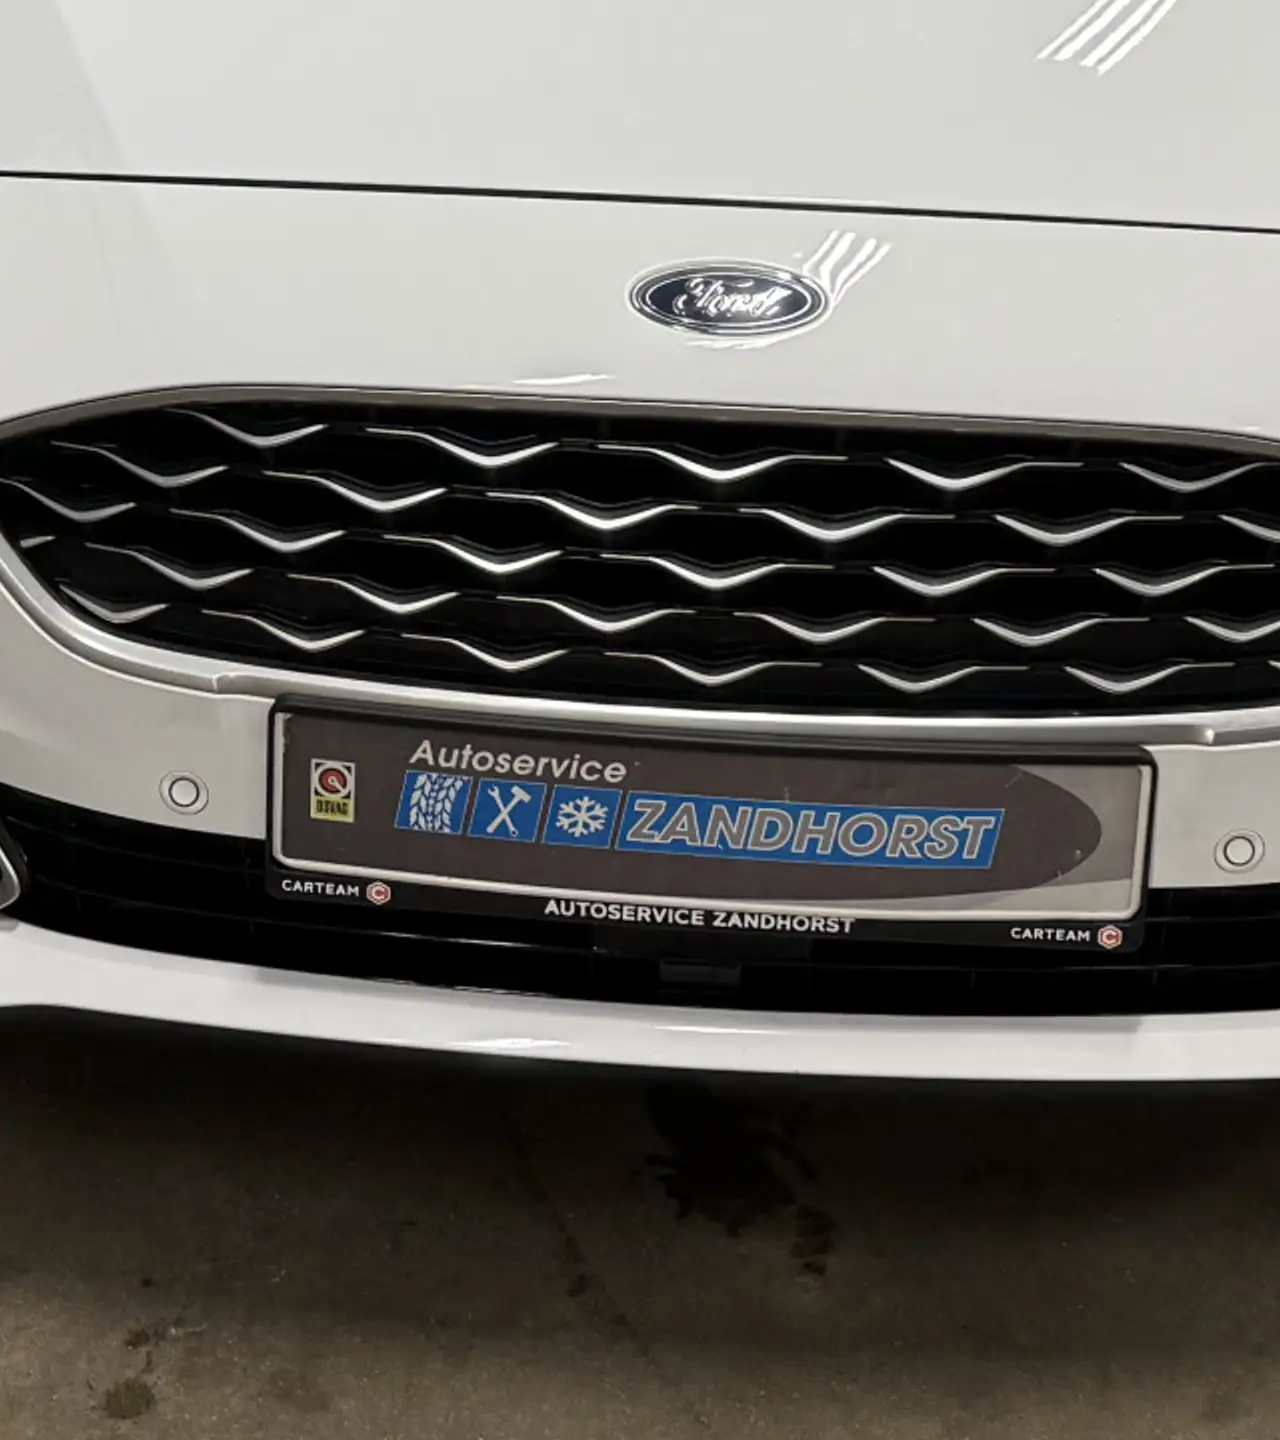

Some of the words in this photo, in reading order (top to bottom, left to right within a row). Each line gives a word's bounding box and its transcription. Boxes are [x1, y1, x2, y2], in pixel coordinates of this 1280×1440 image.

[672, 275, 792, 318] Ford
[409, 740, 627, 783] Autoservice
[626, 799, 995, 859] ZANDHORST
[282, 880, 359, 897] CARTEAM
[544, 899, 705, 926] AUTOSERVICE
[712, 910, 856, 933] ZANDHORST
[1010, 927, 1091, 942] CARTEAM
